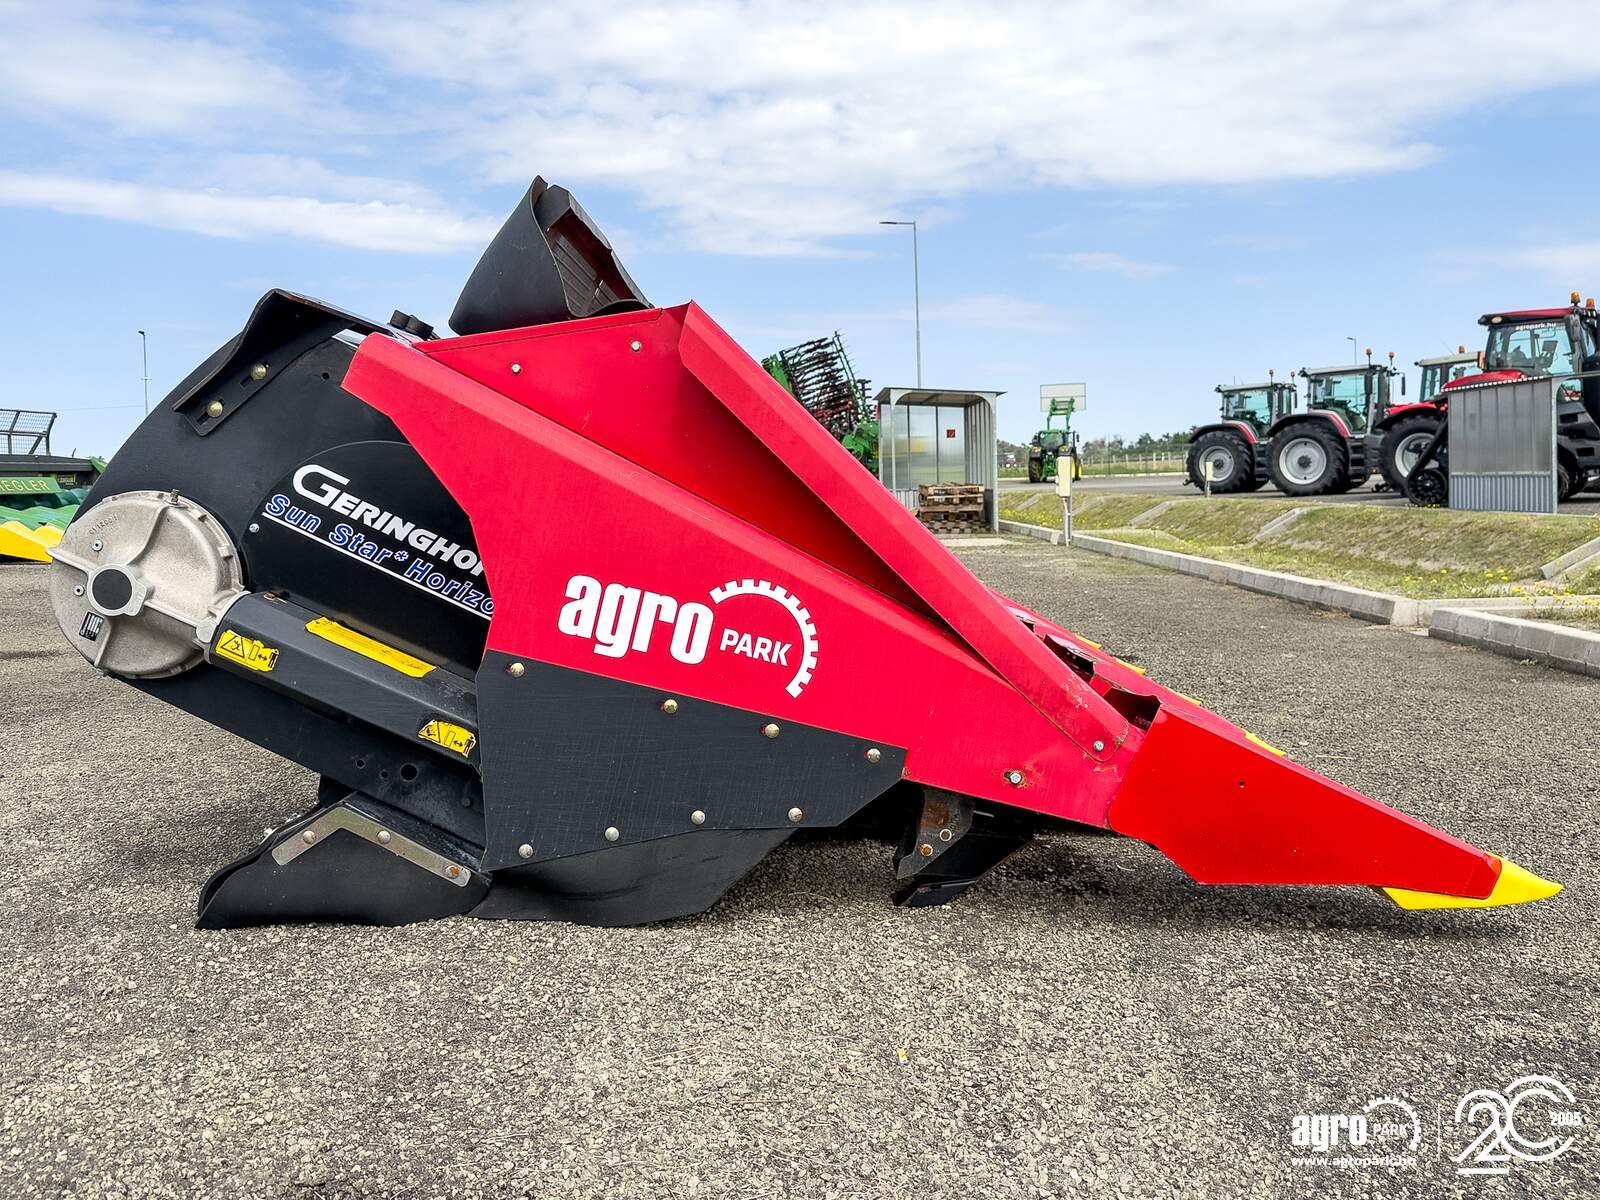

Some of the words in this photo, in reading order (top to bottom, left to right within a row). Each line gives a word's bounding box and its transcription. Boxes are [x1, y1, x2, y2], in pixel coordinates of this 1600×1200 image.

[265, 494, 322, 533] Sun
[557, 574, 714, 665] agro
[719, 628, 792, 667] PARK
